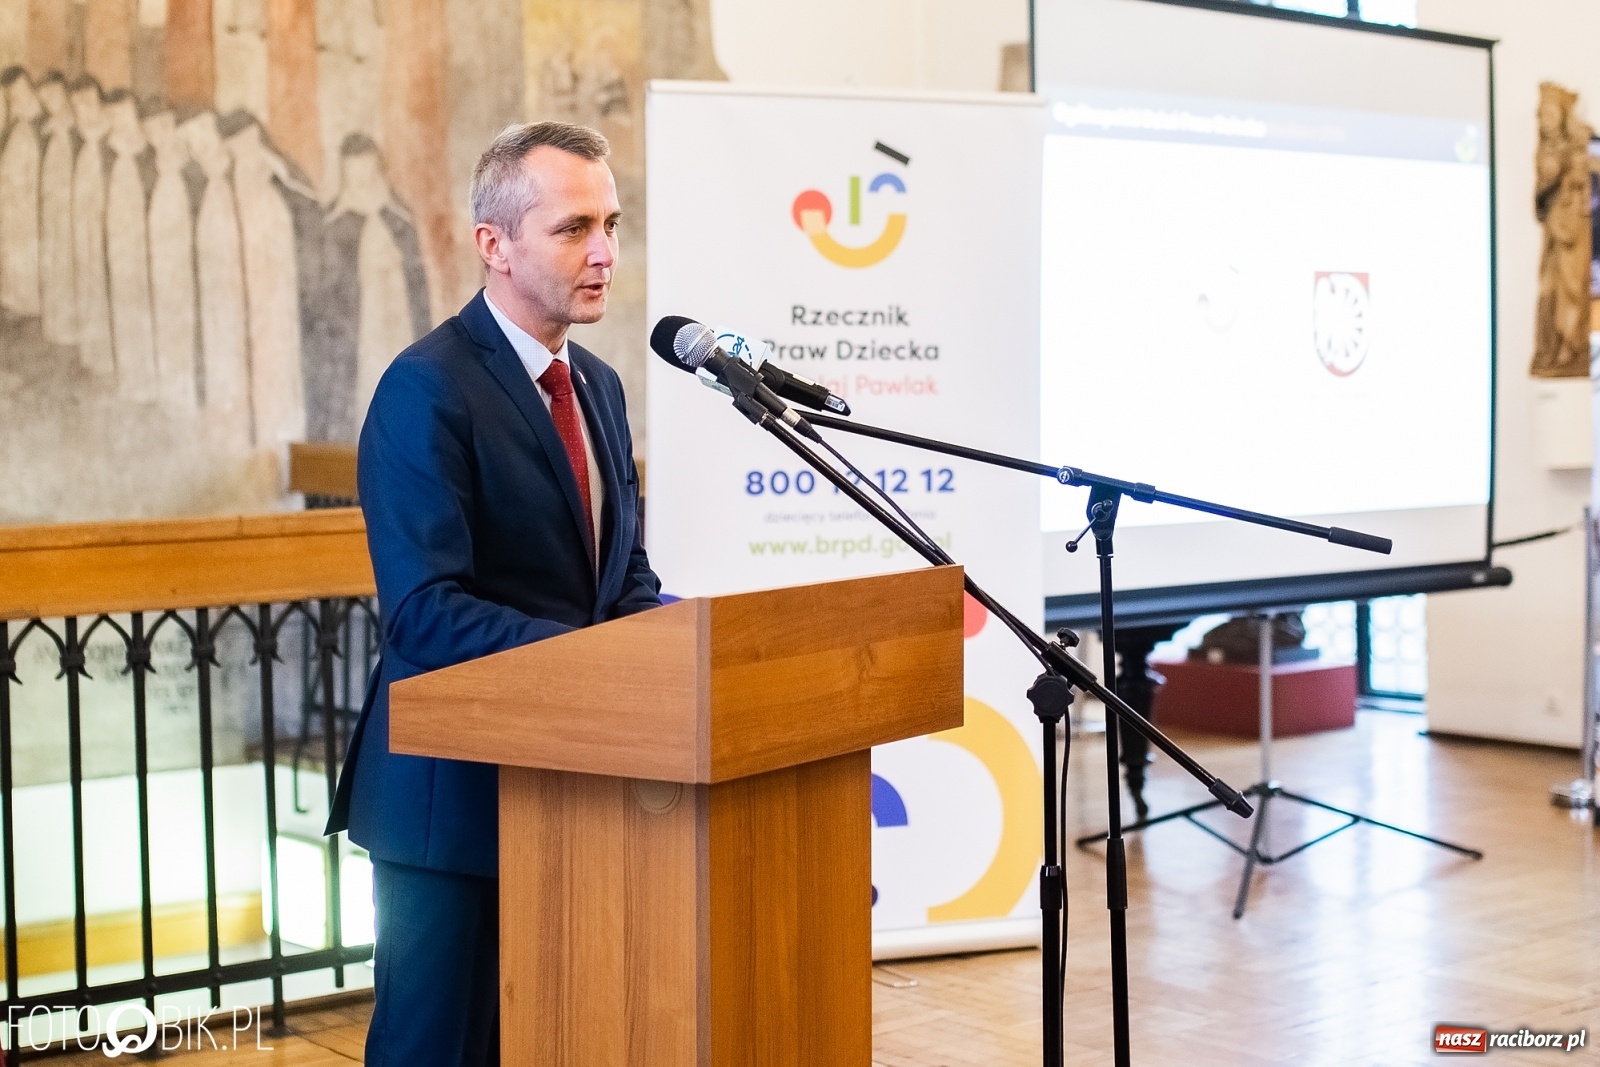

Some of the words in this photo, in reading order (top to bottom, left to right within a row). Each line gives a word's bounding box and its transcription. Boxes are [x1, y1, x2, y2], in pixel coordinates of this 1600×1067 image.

[791, 304, 910, 326] Rzecznik
[836, 339, 940, 361] Dziecka
[854, 374, 938, 396] Pawlak
[745, 470, 816, 495] 800
[875, 468, 908, 492] 12
[920, 467, 955, 492] 12
[748, 532, 952, 559] www.brpd.gol
